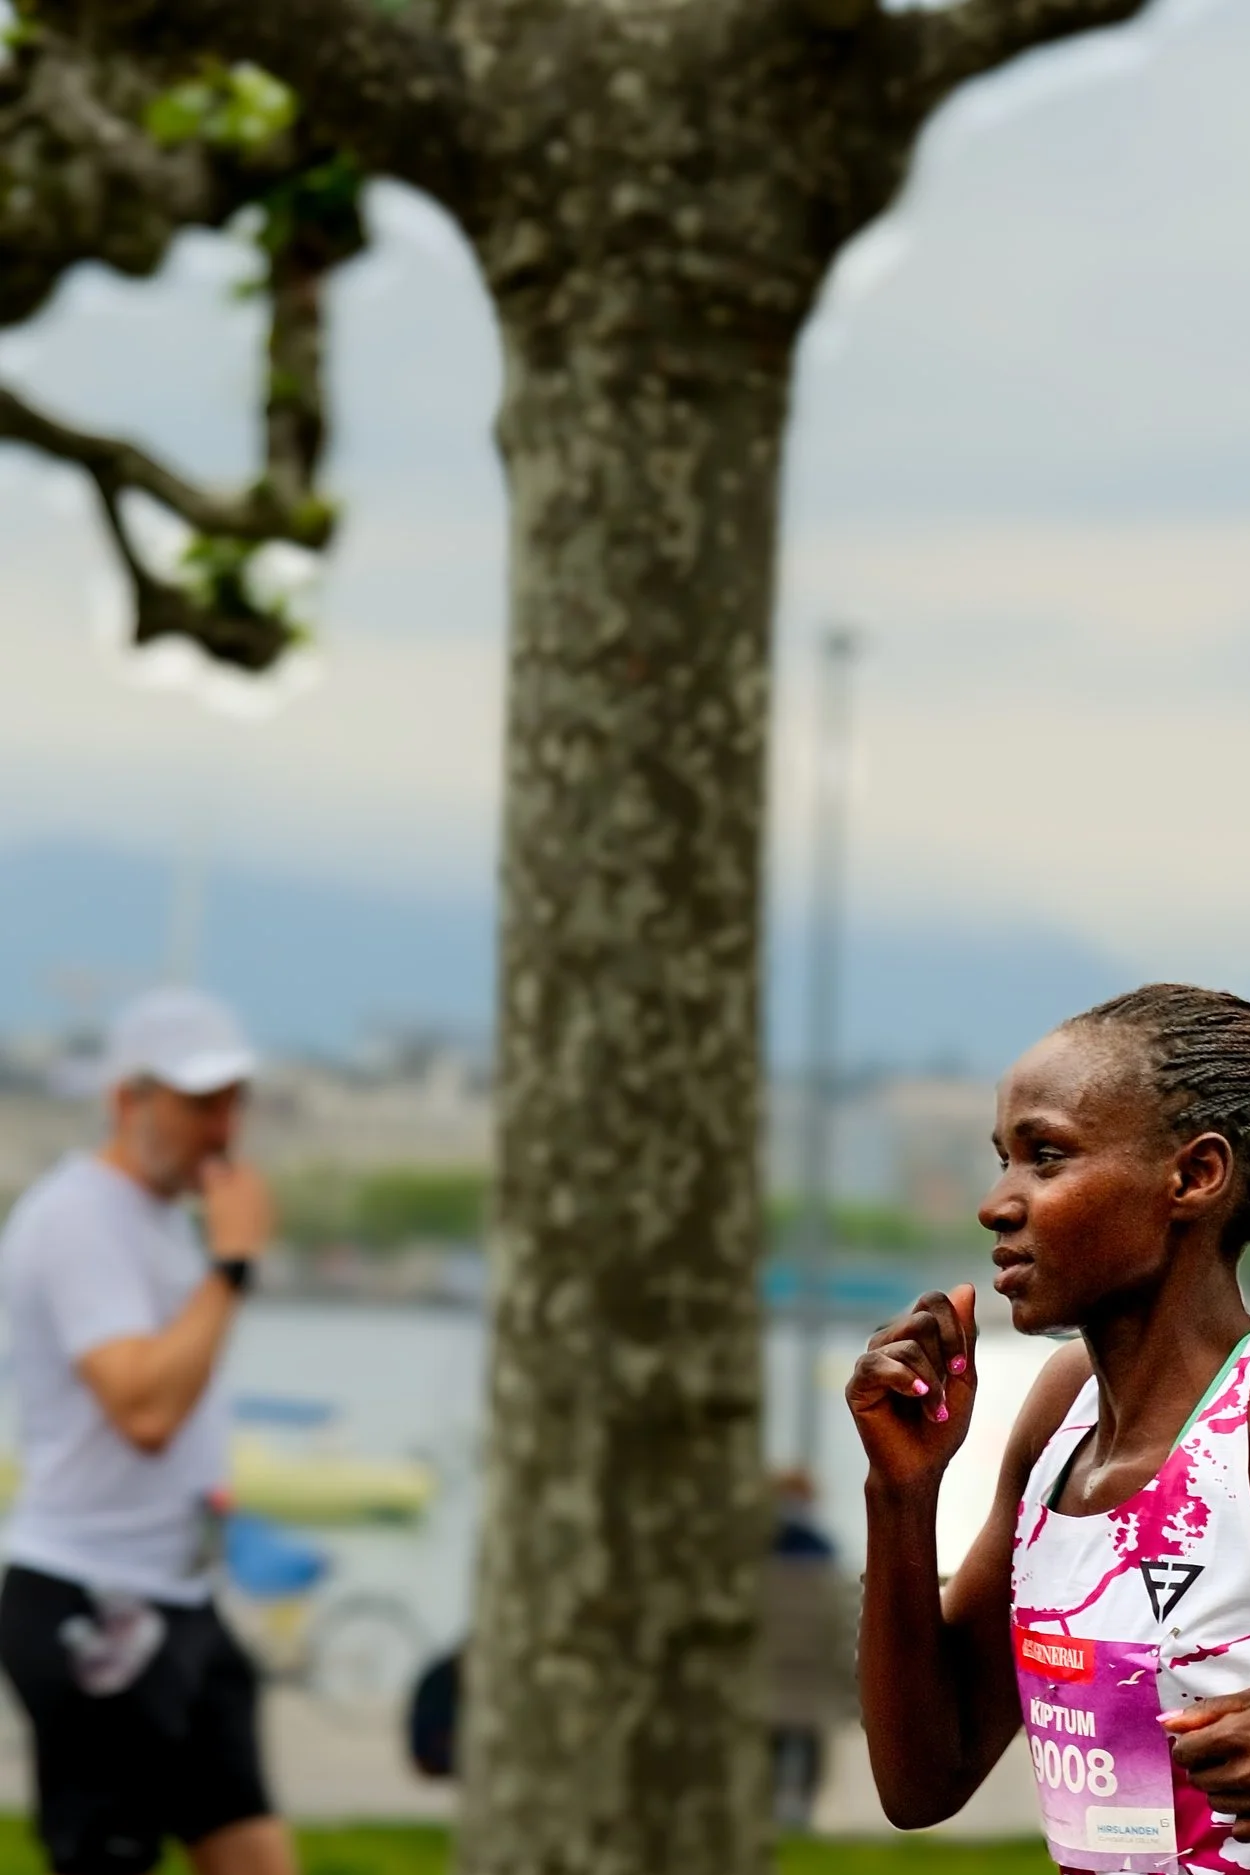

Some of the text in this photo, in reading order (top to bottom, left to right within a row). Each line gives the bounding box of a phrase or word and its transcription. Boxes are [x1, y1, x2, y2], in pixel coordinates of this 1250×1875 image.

[1030, 1698, 1096, 1738] KIPTUM
[1031, 1734, 1118, 1797] 9008
[1097, 1824, 1160, 1836] HIRSLANDEN
